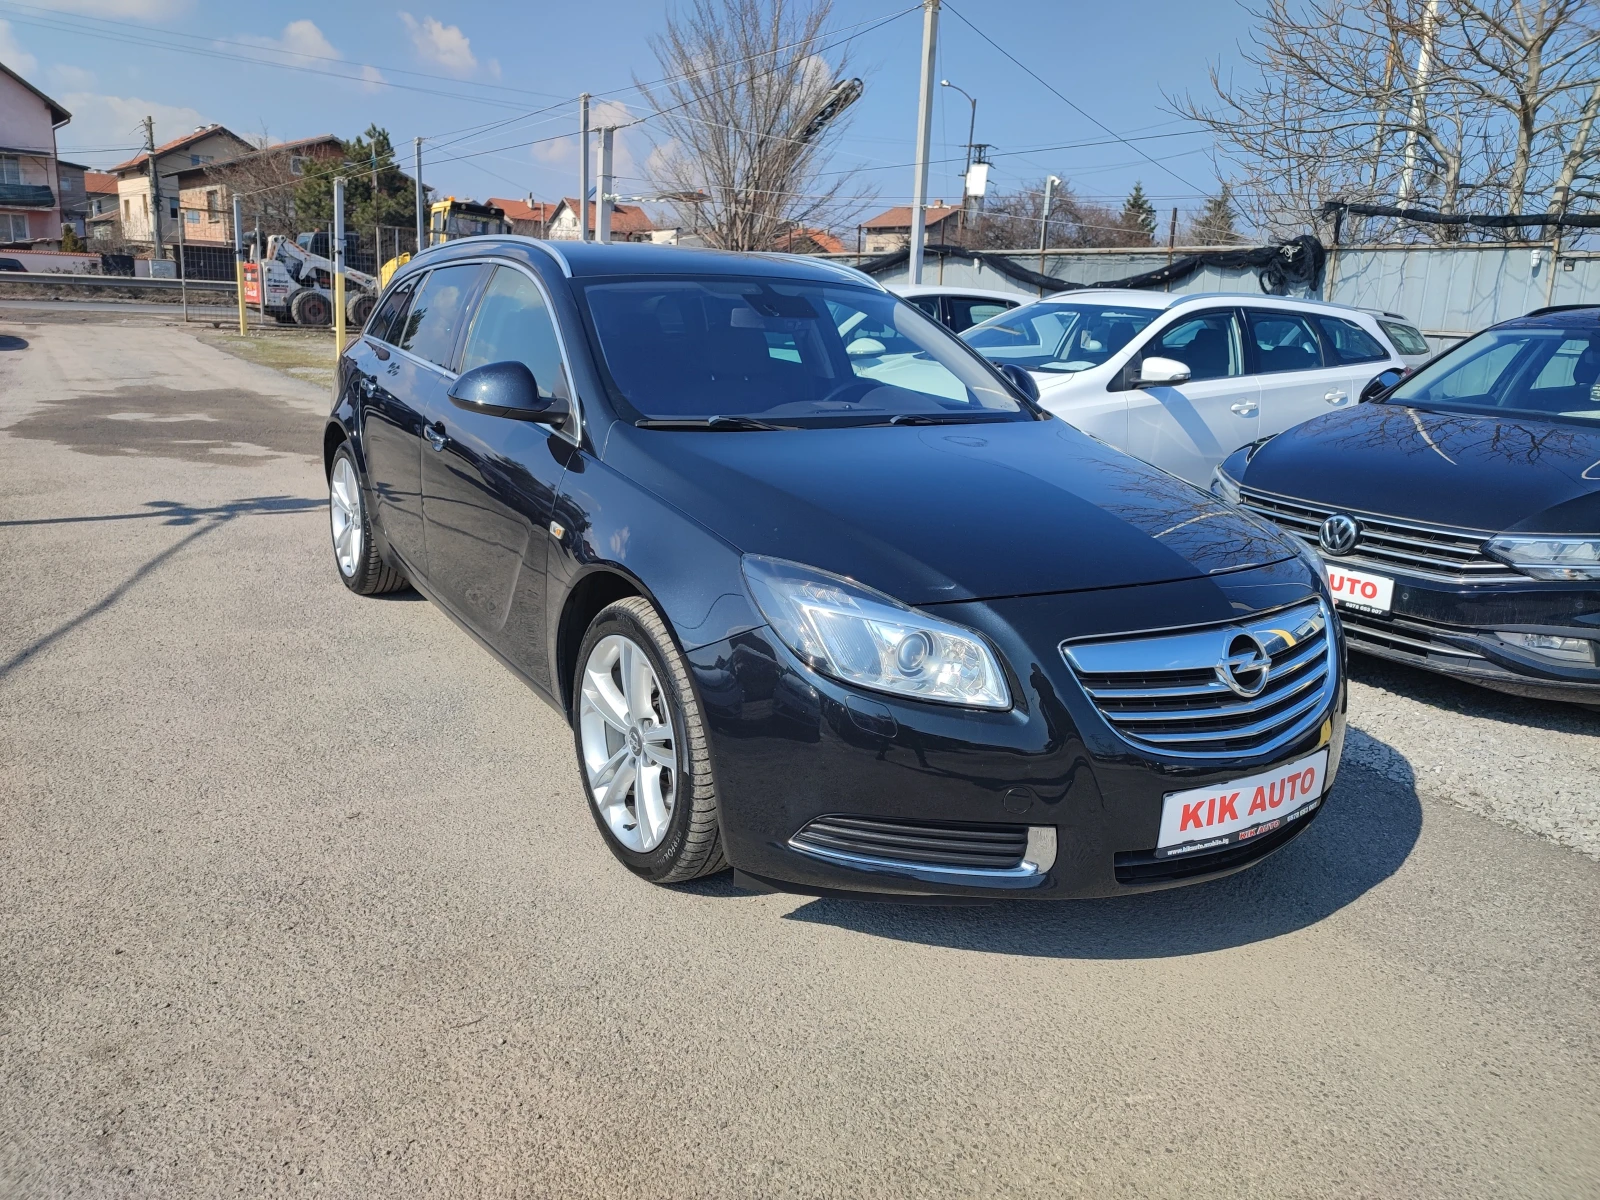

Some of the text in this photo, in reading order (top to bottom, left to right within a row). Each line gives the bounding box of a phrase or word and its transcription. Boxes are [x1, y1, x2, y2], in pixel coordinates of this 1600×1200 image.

[1330, 573, 1378, 599] UTO
[1179, 767, 1315, 832] KIK AUTO
[1256, 819, 1281, 835] AUTO
